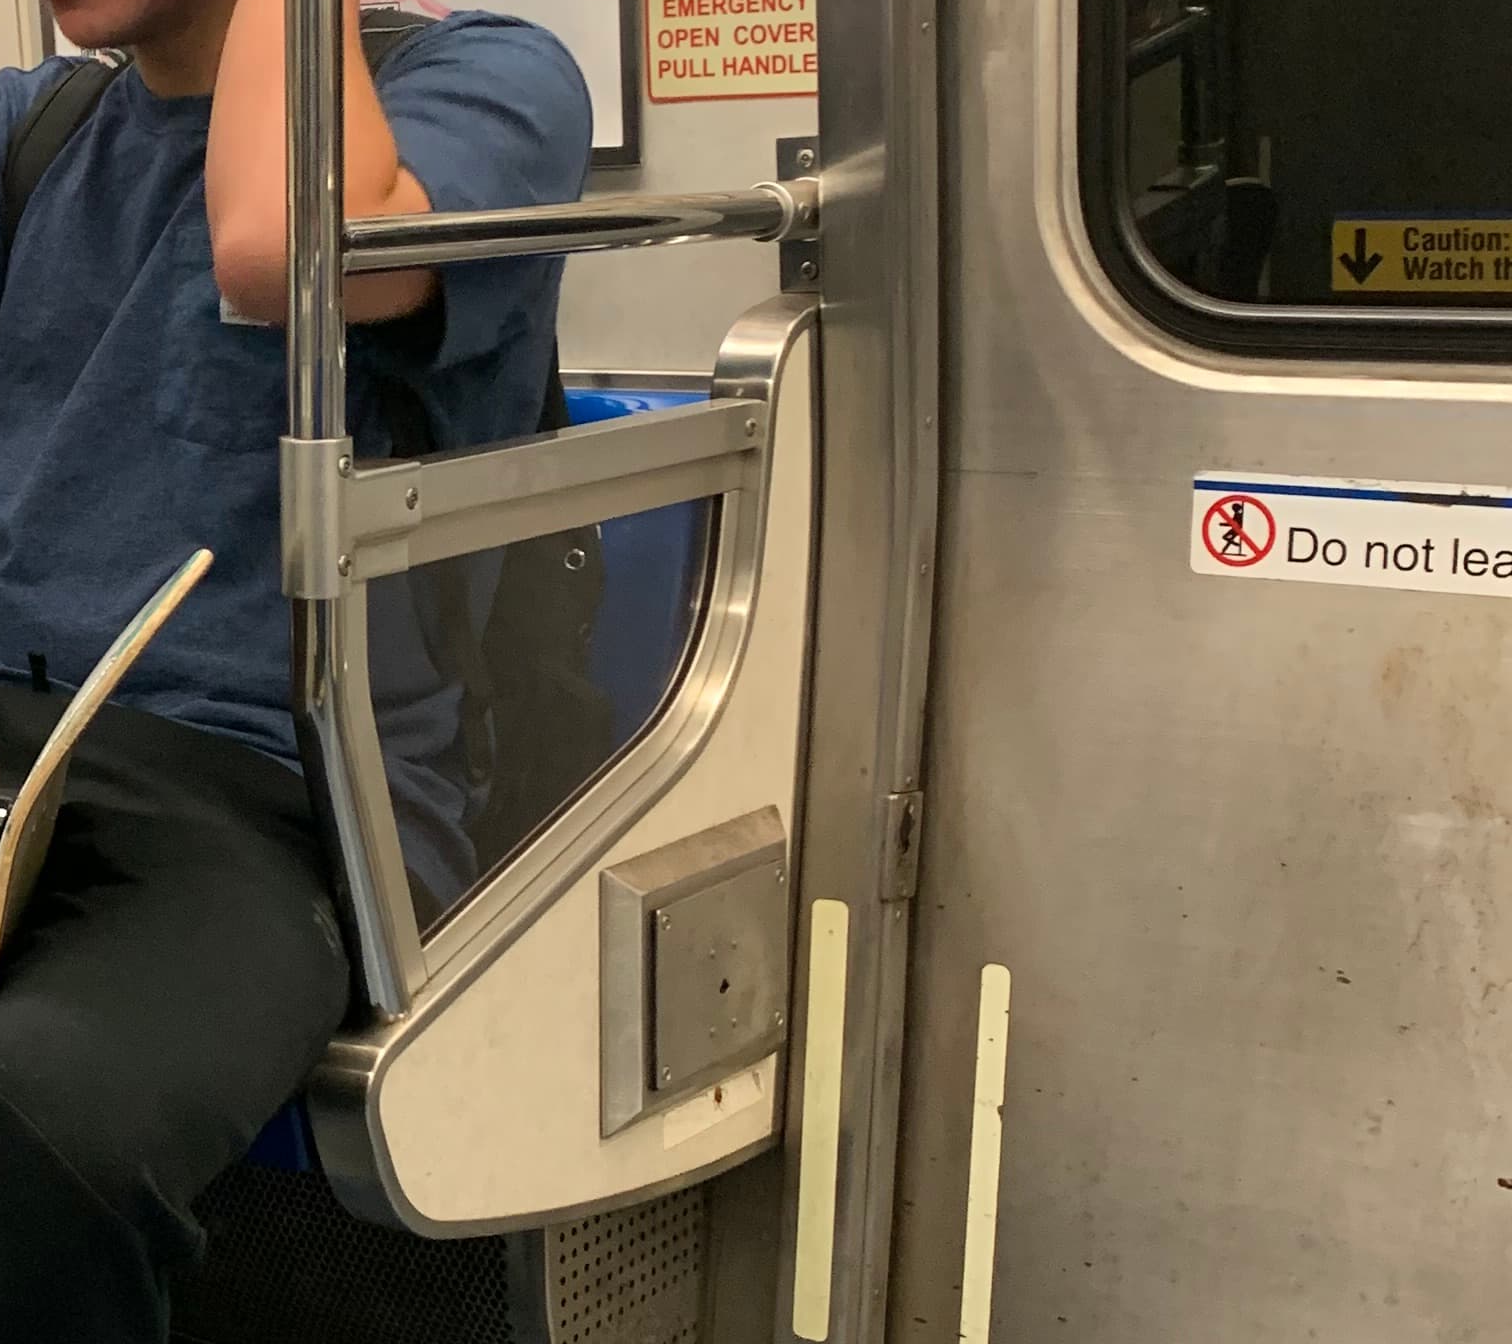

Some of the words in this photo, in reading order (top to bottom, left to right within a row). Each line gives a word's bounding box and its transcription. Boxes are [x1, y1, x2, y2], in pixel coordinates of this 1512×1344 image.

[657, 27, 720, 49] OPEN
[734, 22, 815, 46] COVER
[658, 58, 716, 79] PULL
[722, 53, 818, 76] HANDLE
[1403, 226, 1510, 252] Caution:
[1403, 256, 1483, 281] Watch
[1287, 527, 1347, 566] Do
[1365, 538, 1435, 573] not
